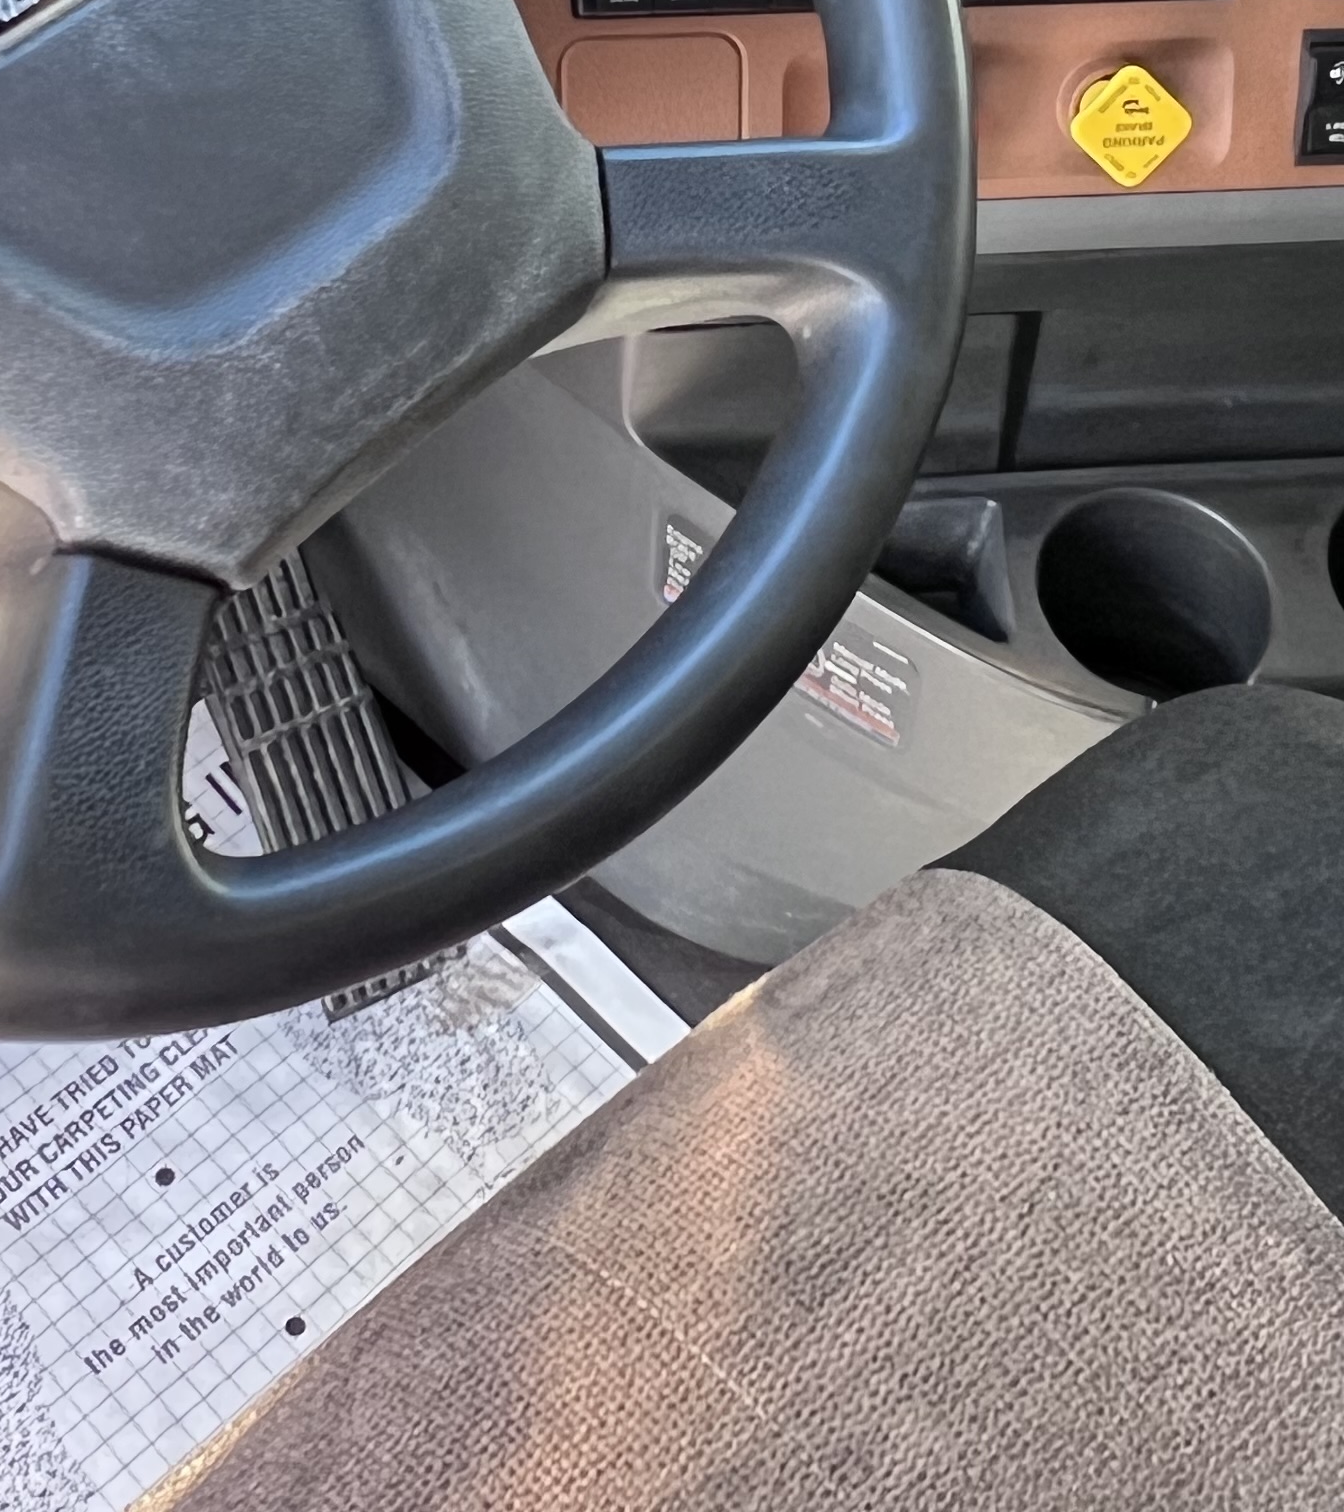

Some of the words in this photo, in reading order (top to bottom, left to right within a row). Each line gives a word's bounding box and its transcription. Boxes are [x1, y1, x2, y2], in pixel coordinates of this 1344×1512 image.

[3, 1177, 68, 1231] WITH
[62, 1133, 121, 1181] THIS
[119, 1073, 193, 1139] PAPER
[190, 1031, 239, 1080] MAT
[37, 1062, 160, 1164] CARPETING
[50, 1054, 119, 1110] TRIED
[83, 1338, 126, 1375] the
[128, 1286, 188, 1340] most
[184, 1194, 293, 1291] important
[292, 1134, 365, 1205] person
[133, 1267, 154, 1291] A
[155, 1182, 253, 1272] customer
[252, 1163, 280, 1188] is
[151, 1339, 181, 1365] in
[178, 1305, 221, 1341] the
[220, 1244, 285, 1308] world
[281, 1227, 310, 1253] to
